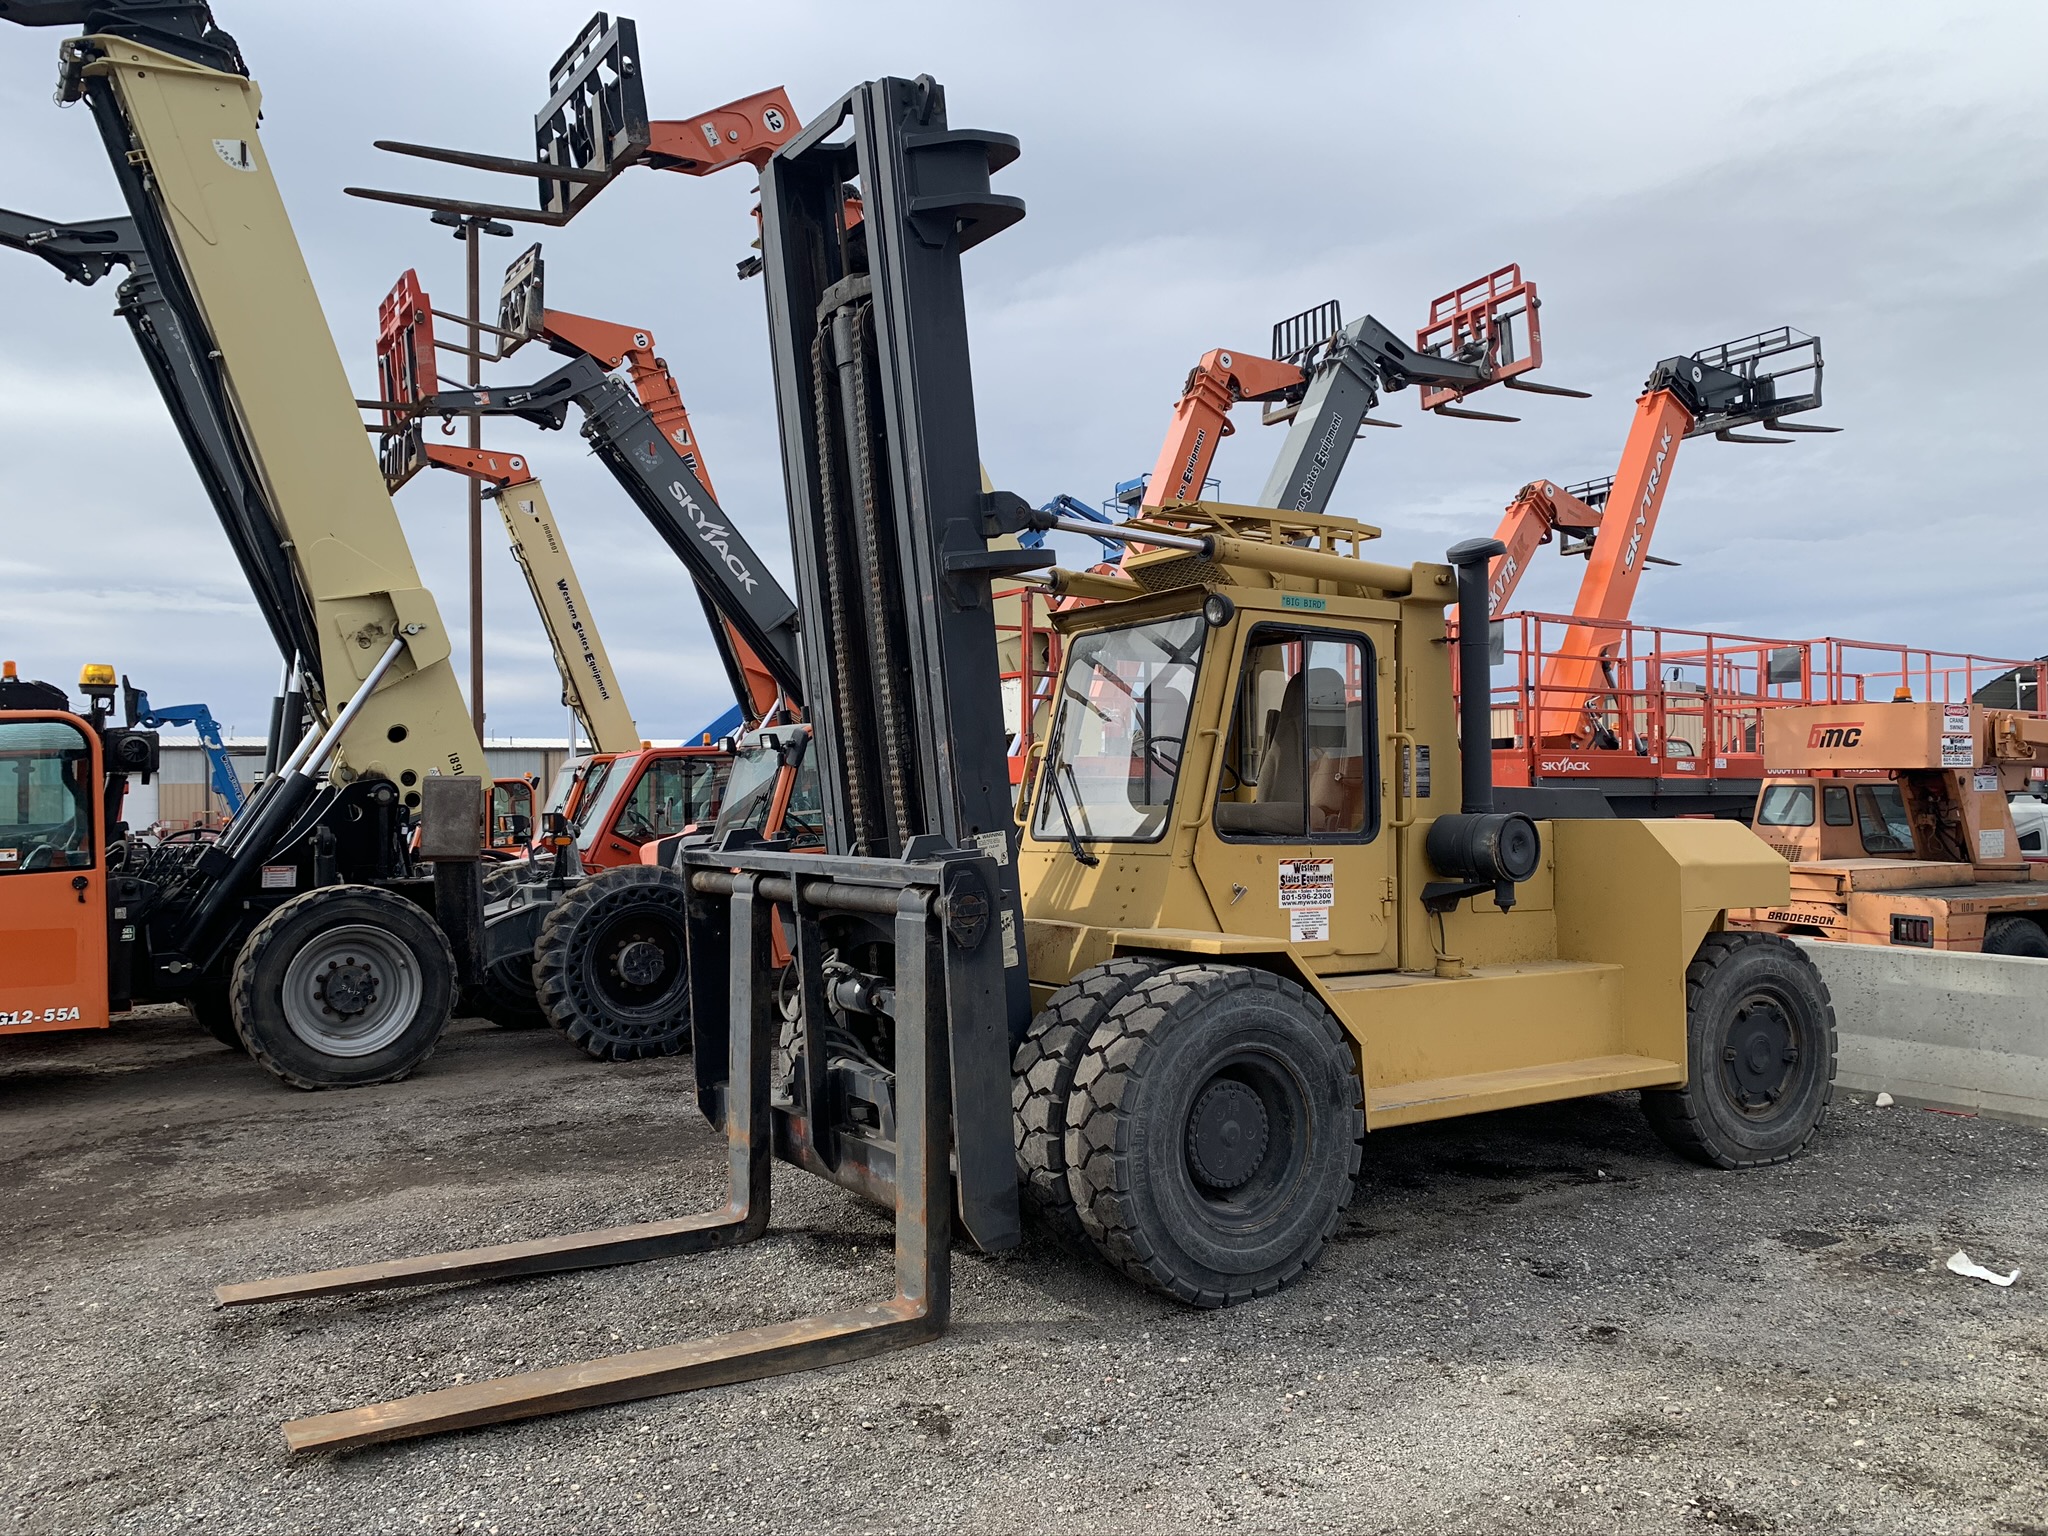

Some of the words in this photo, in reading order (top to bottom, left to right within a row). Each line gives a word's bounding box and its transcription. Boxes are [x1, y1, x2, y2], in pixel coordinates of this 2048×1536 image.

[765, 110, 782, 131] 12
[635, 333, 646, 347] 10
[1180, 429, 1206, 486] Equipment
[1300, 466, 1322, 502] States
[1313, 412, 1343, 470] Equipment
[1625, 423, 1673, 571] SKYTRAK
[668, 481, 759, 594] SKYJACK
[557, 578, 577, 620] Western
[572, 621, 590, 651] States
[584, 652, 610, 701] Equipment
[1807, 722, 1864, 749] bmc
[1541, 757, 1591, 773] SKYJACK
[1294, 863, 1320, 873] Western
[1280, 874, 1300, 886] States
[1301, 874, 1333, 886] Equipment
[1281, 893, 1332, 901] 801-596-2300
[1768, 912, 1835, 925] BRODERSON
[0, 1006, 80, 1026] G12-55A
